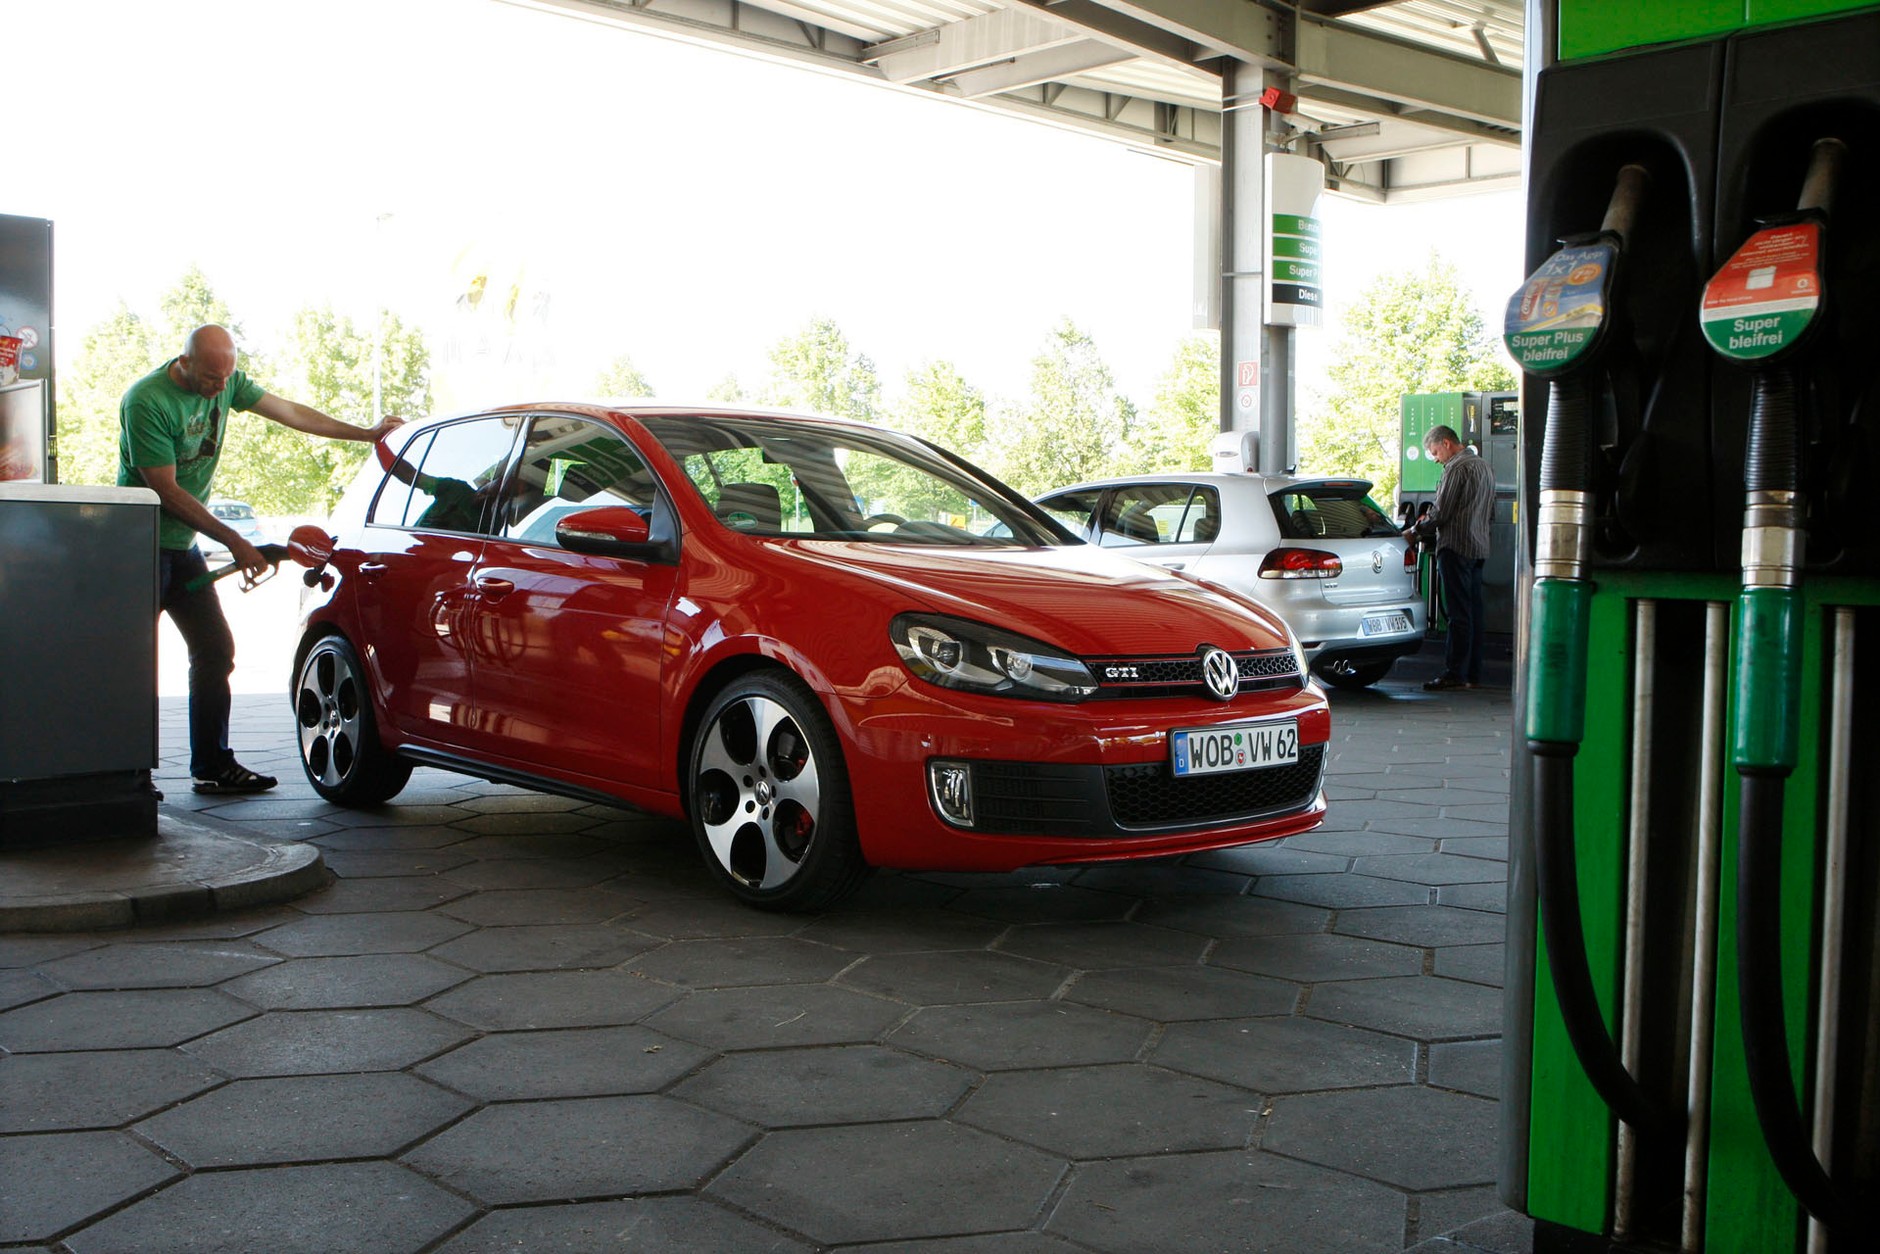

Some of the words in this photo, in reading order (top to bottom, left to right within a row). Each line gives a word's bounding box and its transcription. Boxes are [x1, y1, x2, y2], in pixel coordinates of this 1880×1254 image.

[1299, 242, 1319, 255] Supe
[1289, 264, 1312, 278] Super
[1733, 317, 1781, 333] Super
[1512, 334, 1551, 348] Super
[1554, 331, 1584, 344] Plus
[1729, 330, 1783, 349] bleifrei
[1522, 347, 1569, 362] bleifrei
[1105, 667, 1139, 678] GTI
[1189, 734, 1234, 769] WOB
[1248, 730, 1272, 762] VW
[1276, 728, 1297, 759] 62
